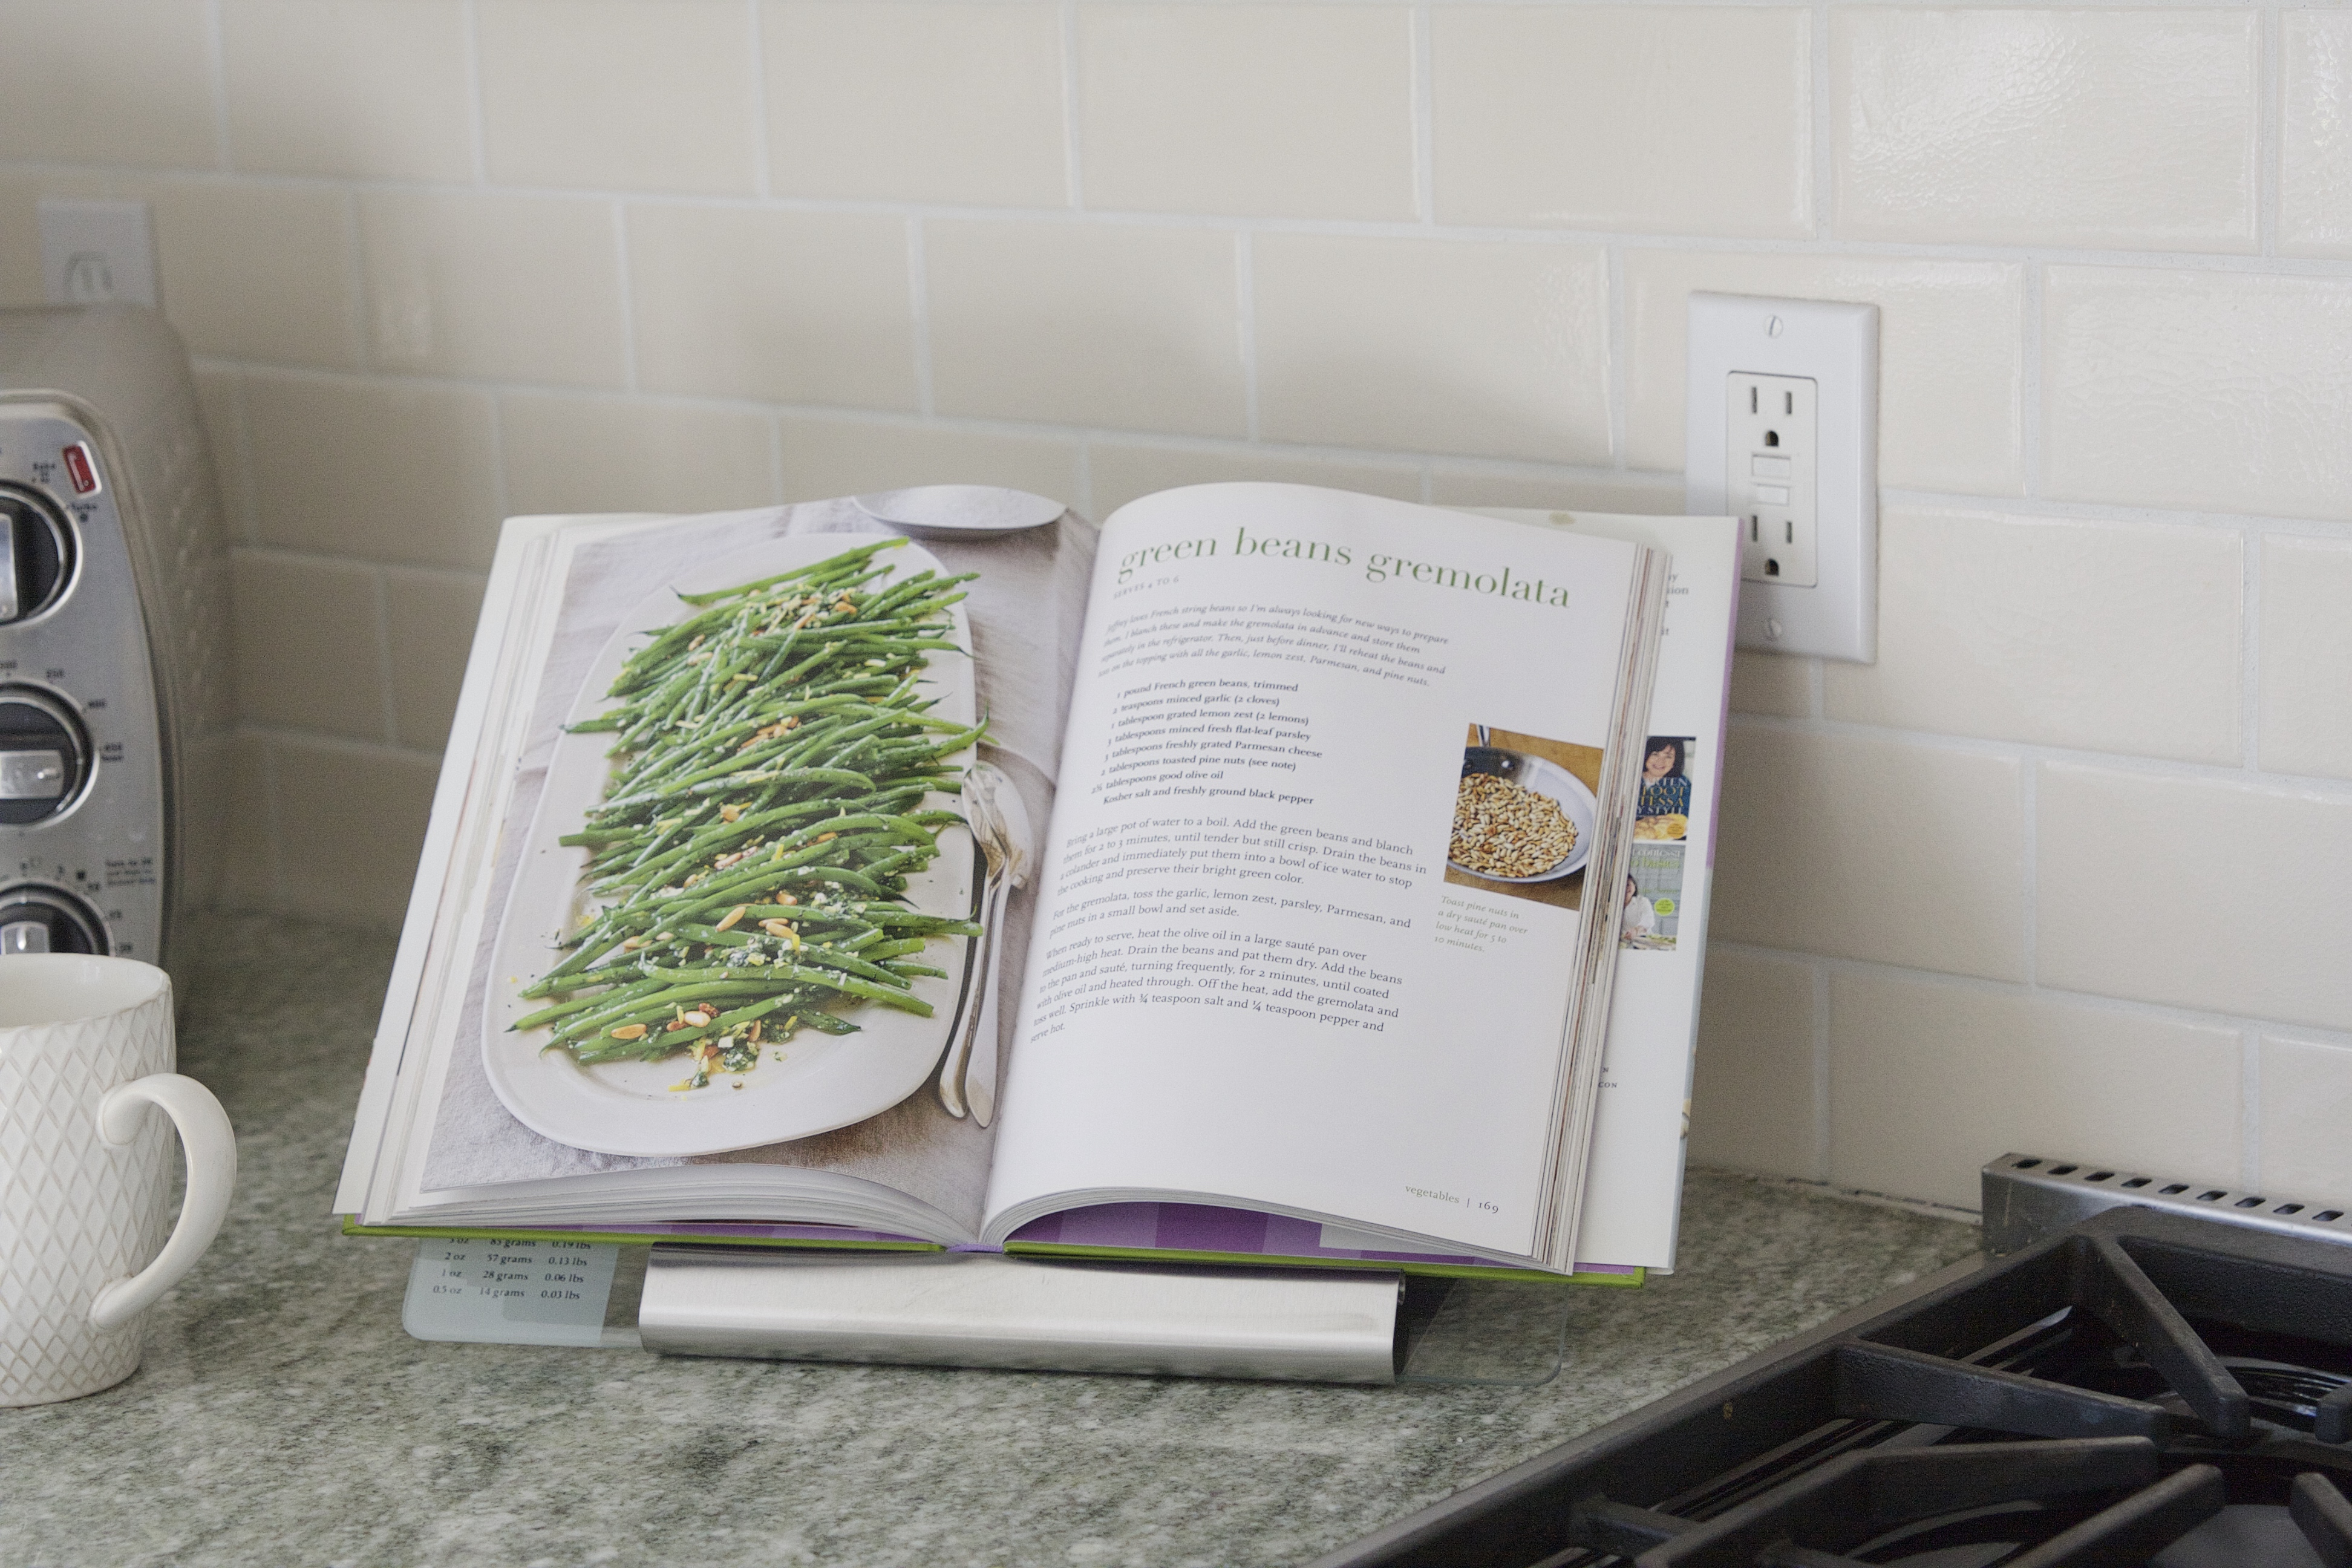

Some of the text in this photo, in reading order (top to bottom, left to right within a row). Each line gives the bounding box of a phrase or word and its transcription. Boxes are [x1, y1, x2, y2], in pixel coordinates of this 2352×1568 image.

[1117, 526, 1569, 608] green beans gremolata
[1355, 619, 1375, 628] new
[1377, 624, 1399, 635] ways
[1413, 632, 1448, 644] prepare
[1351, 634, 1420, 654] and store them
[1349, 648, 1446, 675] reheat the beans and
[1188, 679, 1298, 691] green beans, trimmed
[1363, 667, 1429, 686] and pine nuts.
[1166, 693, 1279, 707] minced garlic (2 cloves)
[1166, 709, 1197, 721] grated
[1256, 712, 1265, 721] (2
[1269, 711, 1308, 726] lemons)
[1169, 724, 1310, 742] minced fresh flat-leaf parsley
[1166, 740, 1322, 758] freshly grated Parmesan cheese
[1163, 755, 1197, 765] toasted
[1198, 756, 1221, 766] pine
[1249, 758, 1268, 767] (see
[1271, 762, 1296, 772] note)
[1185, 770, 1224, 779] olive oil
[1174, 786, 1313, 805] freshly ground black pepper
[1233, 818, 1413, 855] Add the green beans and blanch
[1243, 835, 1426, 874] but still crisp. Drain the beans in
[1239, 870, 1304, 884] green color.
[1244, 852, 1266, 862] into
[1279, 855, 1305, 867] bowl
[1308, 860, 1322, 870] of
[1323, 862, 1338, 873] ice
[1342, 868, 1372, 880] water
[1376, 874, 1386, 882] to
[1389, 877, 1412, 889] stop
[1252, 895, 1411, 928] zest, parsley, Parmesan, and
[1442, 895, 1519, 919] Toast pine nuts in
[1446, 910, 1462, 922] dry
[1464, 916, 1488, 925] sauté
[1489, 921, 1506, 930] pan
[1436, 921, 1452, 931] low
[1454, 925, 1474, 936] heat
[1474, 929, 1488, 939] for
[1230, 932, 1241, 941] in
[1254, 933, 1282, 948] large
[1285, 941, 1315, 952] sauté
[1318, 946, 1339, 956] pan
[1342, 951, 1367, 961] over
[1446, 939, 1485, 952] minutes.
[1218, 948, 1402, 984] and pat them dry. Add the beans
[1240, 965, 1255, 976] for
[1269, 972, 1318, 987] minutes,
[1323, 981, 1350, 991] until
[1353, 987, 1388, 999] coated
[1221, 980, 1399, 1018] the heat, add the gremolata and
[1227, 999, 1249, 1008] and
[1266, 1004, 1316, 1019] teaspoon
[1319, 1014, 1360, 1027] pepper
[1362, 1022, 1384, 1032] and
[1405, 1186, 1499, 1214] vegetables 169
[503, 1240, 537, 1249] grams
[445, 1252, 452, 1261] 2
[500, 1256, 533, 1266] grams
[548, 1256, 570, 1266] 0.13
[572, 1257, 588, 1266] lbs
[483, 1270, 494, 1279] 28
[496, 1273, 529, 1282] grams
[544, 1273, 566, 1282] 0.06
[569, 1274, 584, 1283] lbs
[480, 1287, 491, 1295] 14
[493, 1290, 525, 1299] grams
[541, 1290, 562, 1298] 0.03
[565, 1290, 580, 1300] lbs
